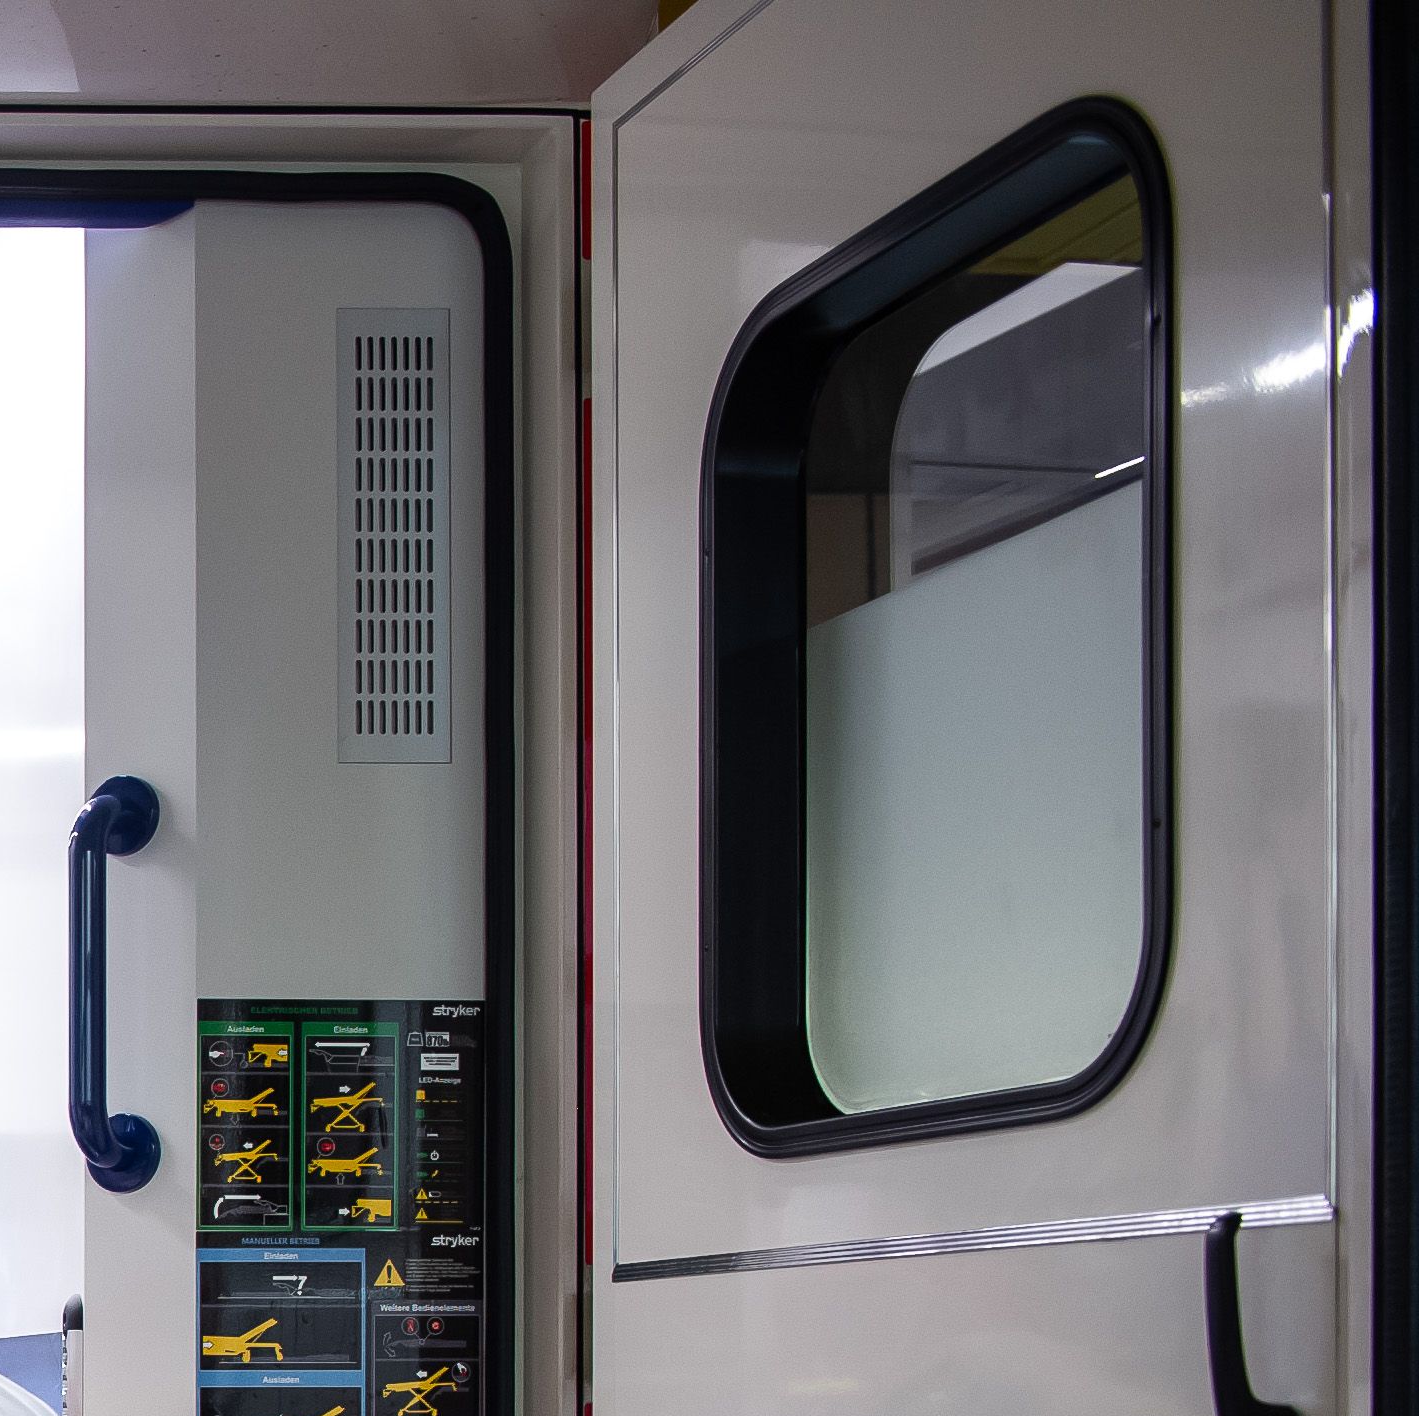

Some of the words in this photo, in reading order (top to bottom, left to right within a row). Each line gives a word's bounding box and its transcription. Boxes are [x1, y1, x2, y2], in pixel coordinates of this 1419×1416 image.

[432, 1004, 481, 1018] stryker
[226, 1024, 265, 1034] Ausladen
[430, 1233, 480, 1248] stryker
